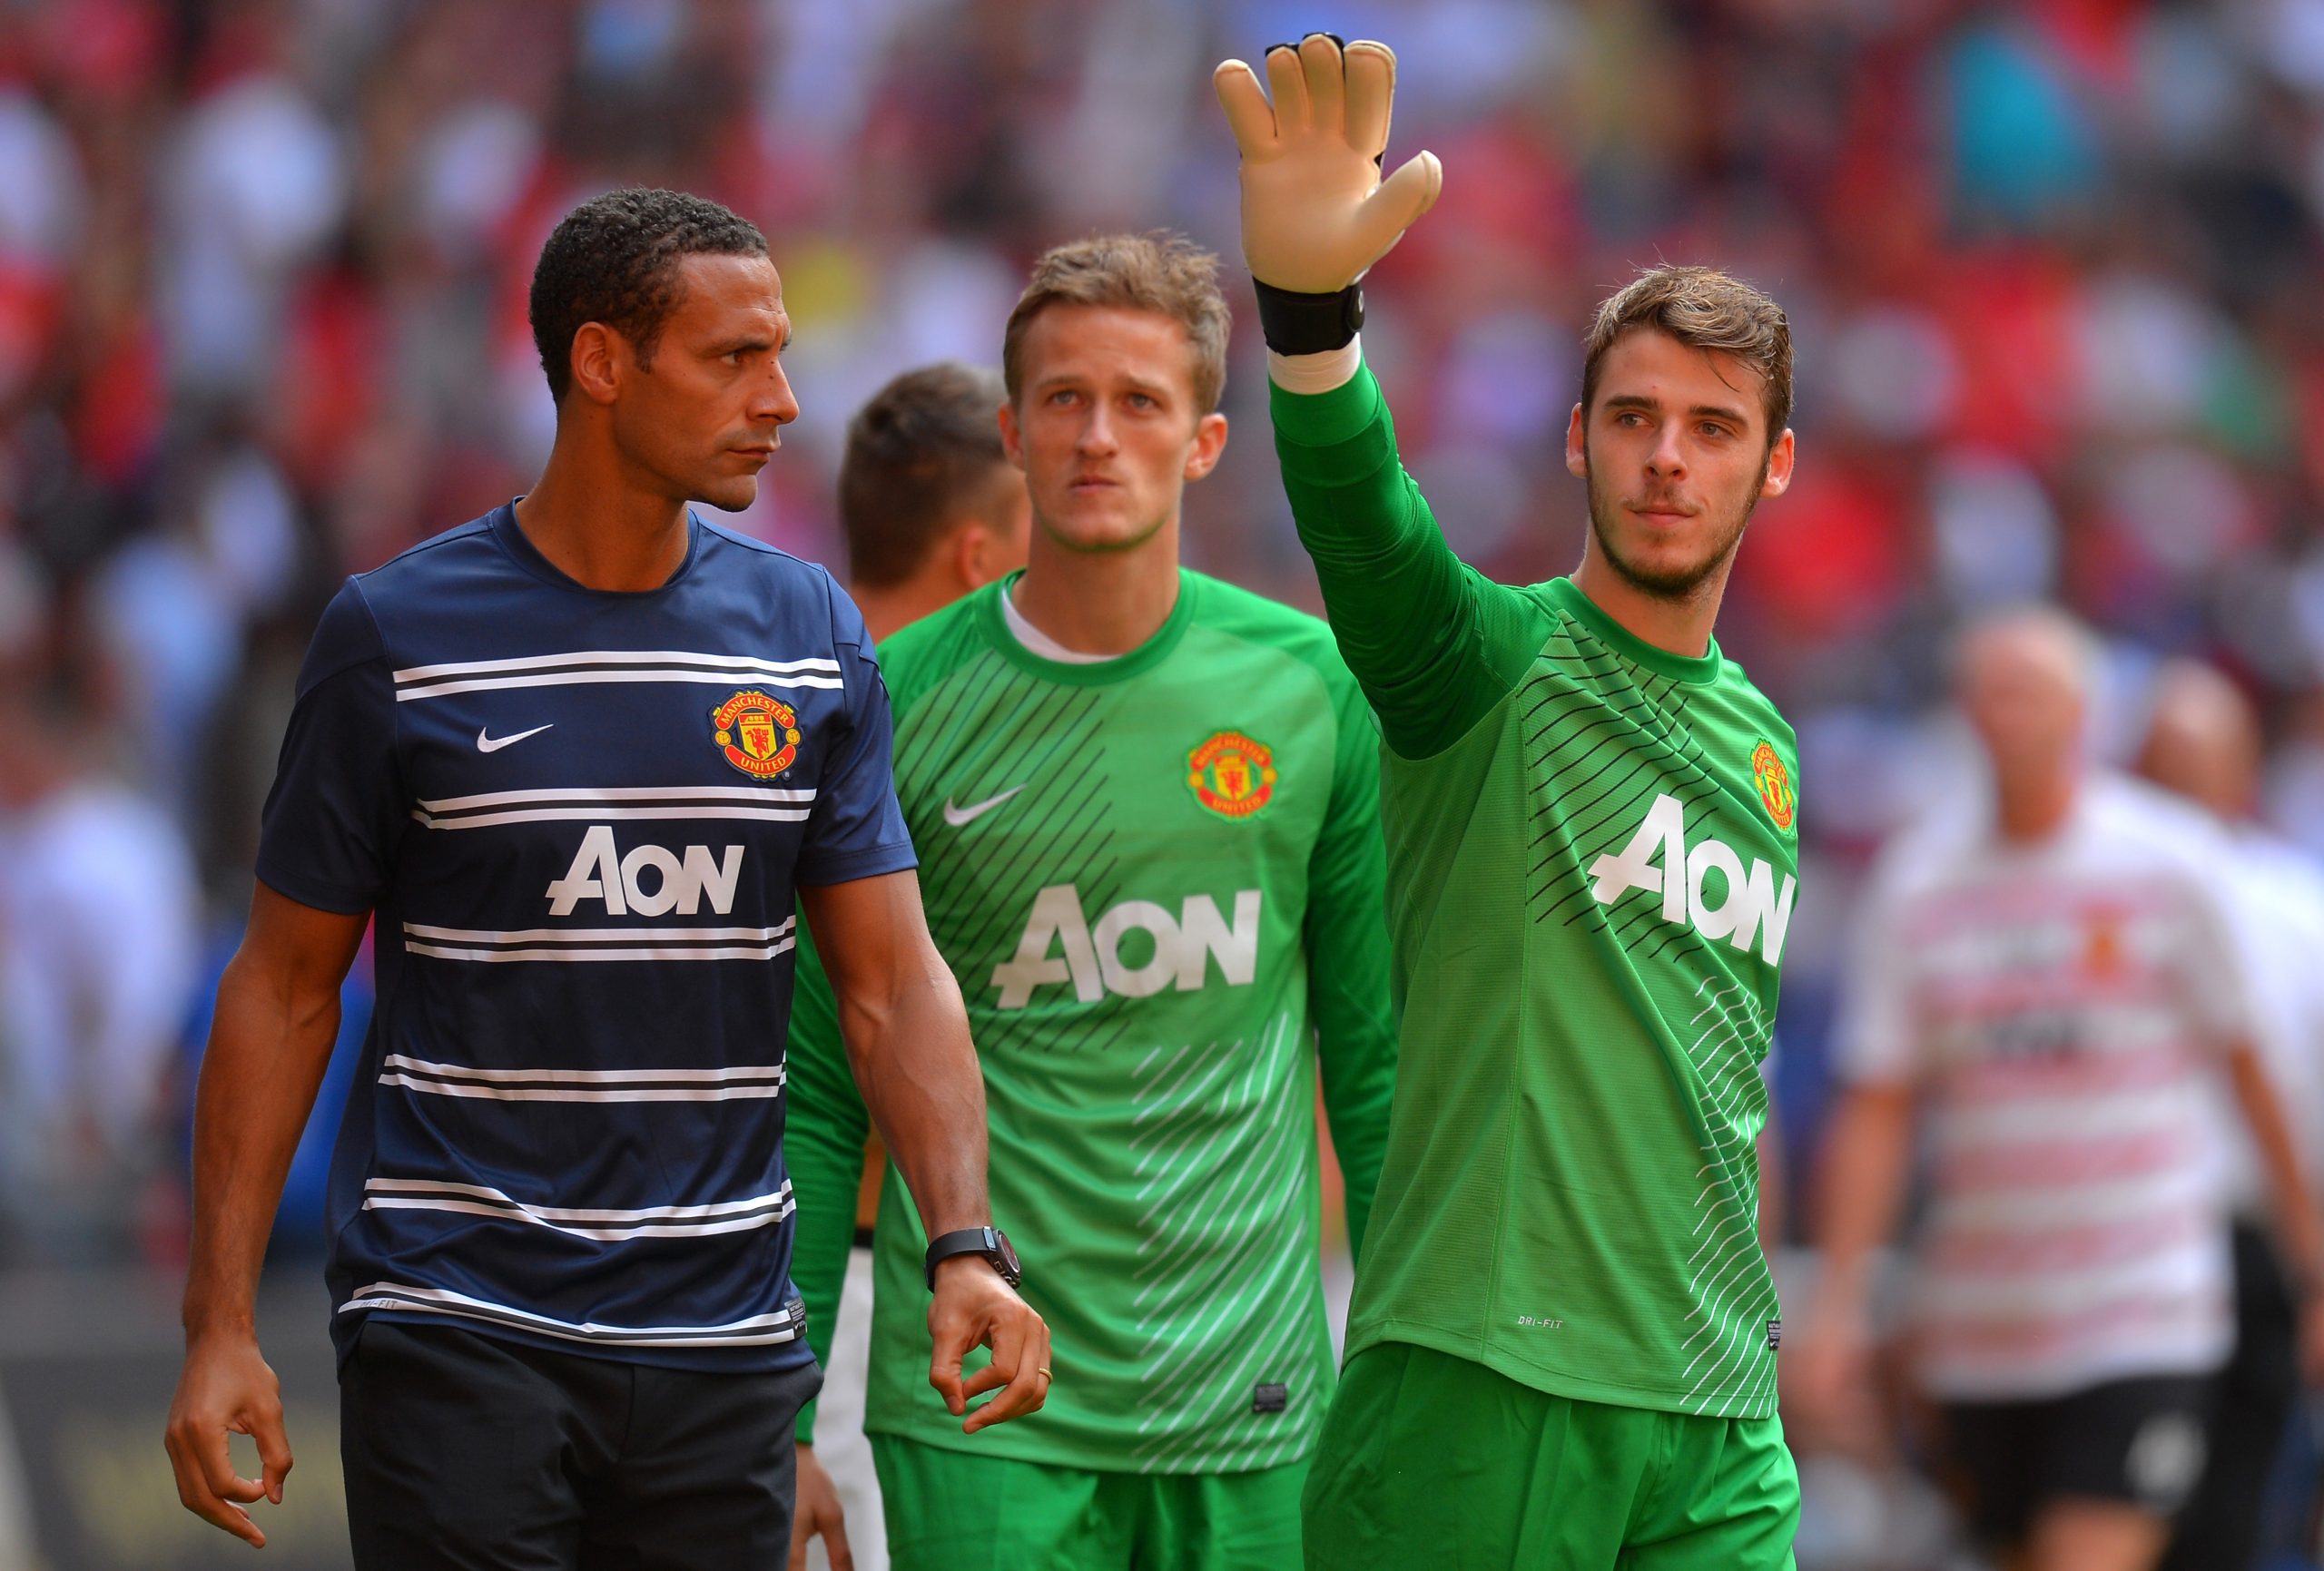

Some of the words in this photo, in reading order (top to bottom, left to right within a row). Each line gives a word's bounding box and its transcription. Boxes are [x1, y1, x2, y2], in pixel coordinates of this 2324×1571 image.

[721, 696, 789, 724] MANCHESTER
[741, 757, 786, 771] UNITED
[545, 825, 745, 918] AON
[1587, 792, 1797, 967] AON
[990, 883, 1262, 1008] AON
[1518, 1315, 1563, 1329] DRI-FIT
